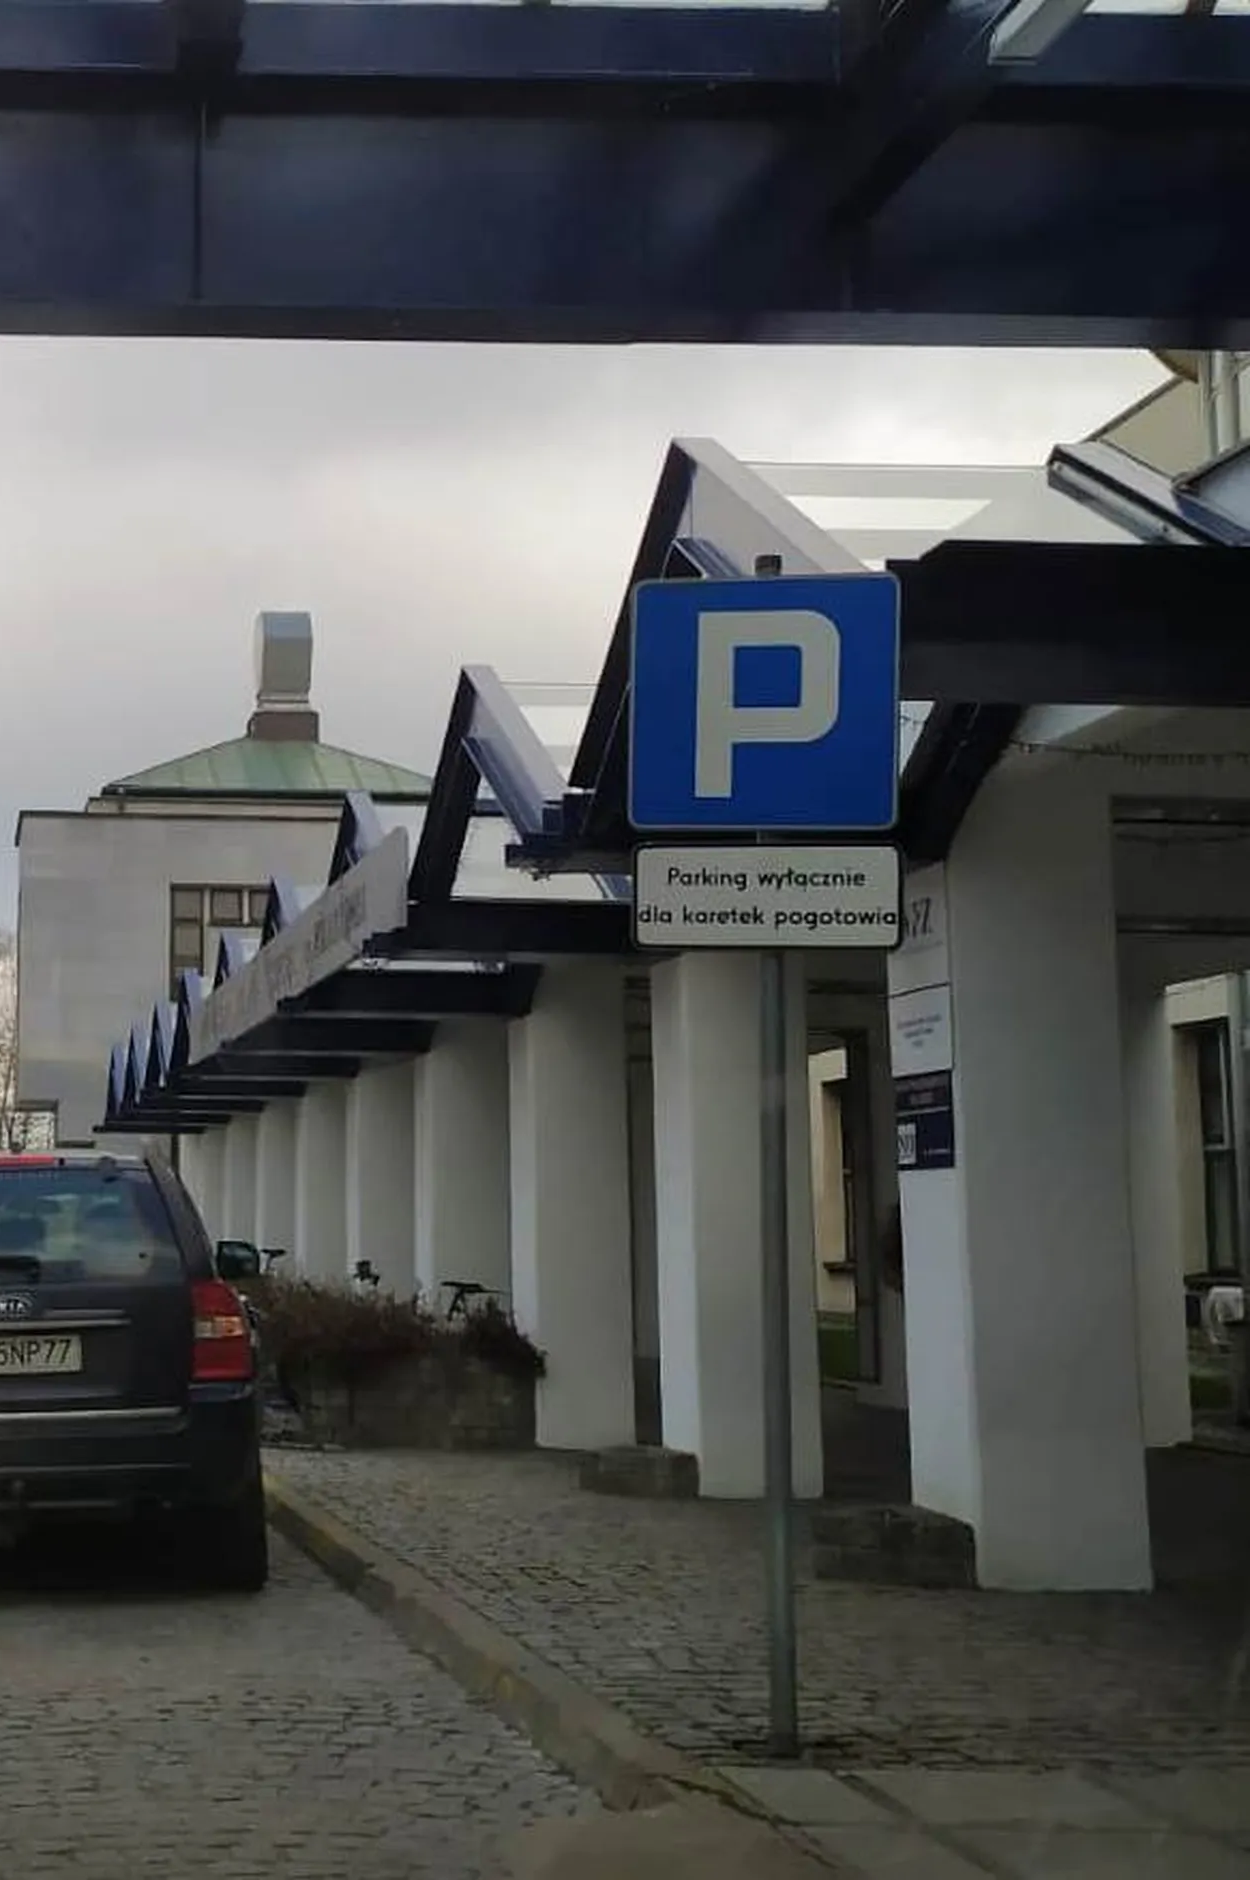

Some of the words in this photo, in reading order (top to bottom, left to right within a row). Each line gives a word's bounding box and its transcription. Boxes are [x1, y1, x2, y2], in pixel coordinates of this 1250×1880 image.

[694, 609, 841, 799] P
[667, 866, 748, 892] Parking
[758, 866, 867, 891] wyłącznie
[637, 904, 673, 926] dla
[682, 904, 765, 926] karetek
[774, 906, 898, 930] pogotowia
